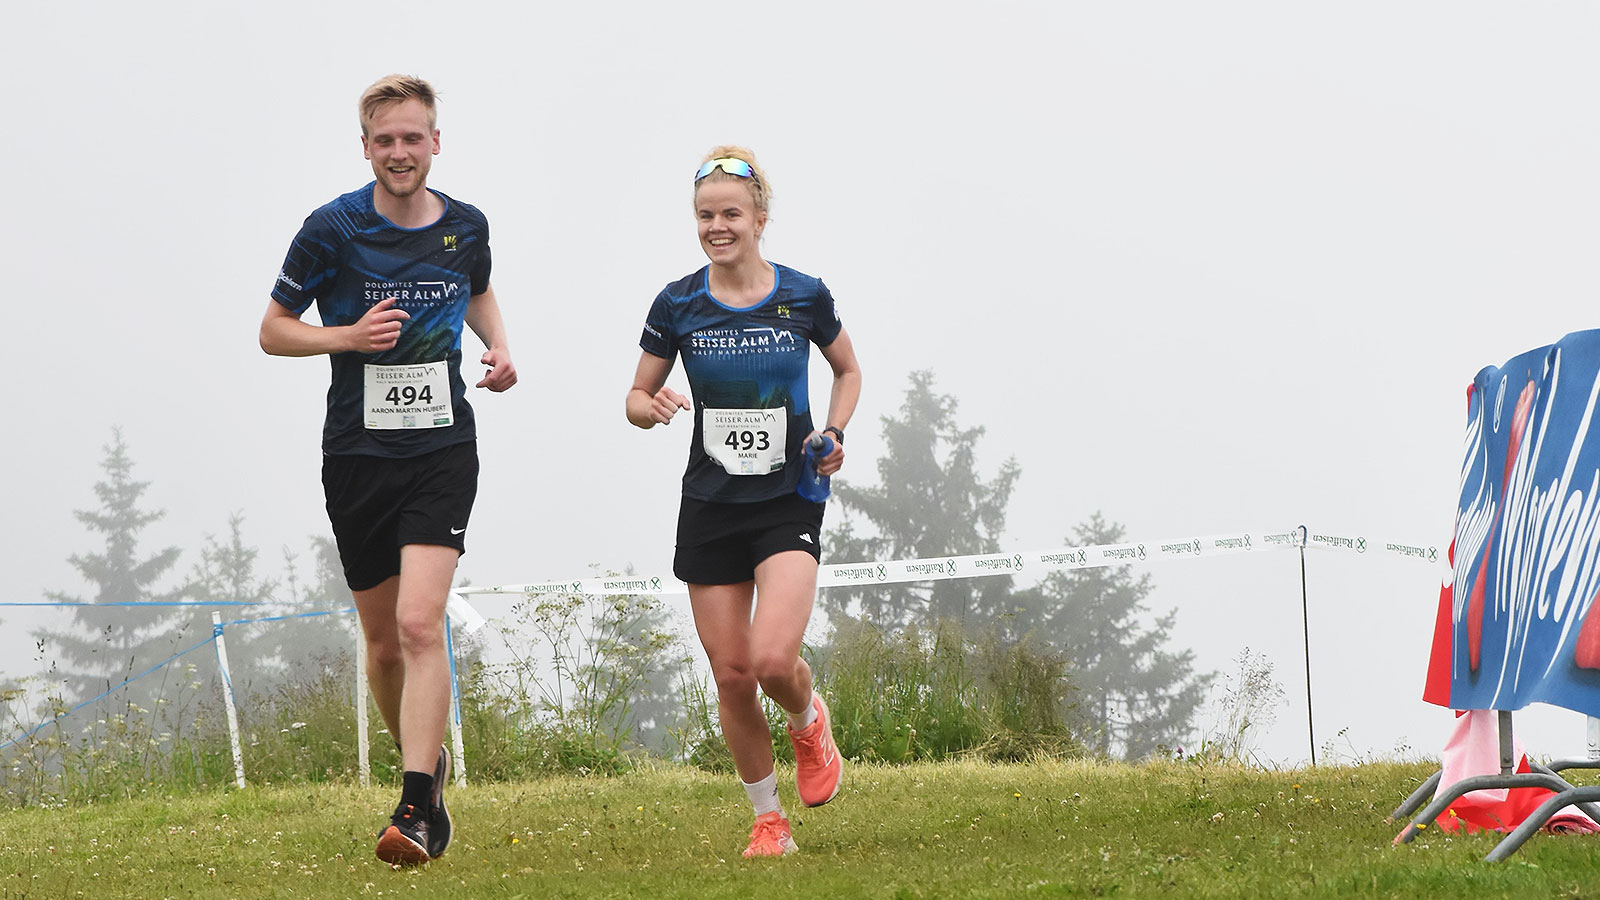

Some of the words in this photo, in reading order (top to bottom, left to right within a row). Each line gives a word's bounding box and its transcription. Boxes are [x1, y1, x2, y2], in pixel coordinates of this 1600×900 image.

[365, 281, 413, 289] DOLOMITES
[364, 290, 410, 300] SEISER
[414, 290, 442, 300] ALM
[692, 329, 739, 337] DOLOMITES
[691, 337, 737, 348] SEISER
[740, 335, 769, 347] ALM
[718, 347, 770, 356] MARATHON
[375, 372, 405, 380] SEISER
[385, 385, 433, 406] 494
[422, 404, 446, 413] HUBERT
[725, 430, 770, 451] 493
[1161, 542, 1192, 554] Raiffeisen
[1214, 537, 1243, 549] Raiffeisen
[1312, 534, 1353, 549] Raiffeisen
[1102, 547, 1136, 560] Raiffeisen
[1386, 543, 1425, 558] Raiffeisen
[974, 557, 1012, 570] Raiffeisen
[1040, 552, 1076, 566] Raiffeisen
[833, 567, 874, 580] Raiffeisen
[906, 562, 945, 575] Raiffeisen
[603, 579, 647, 594] Raiffeisen
